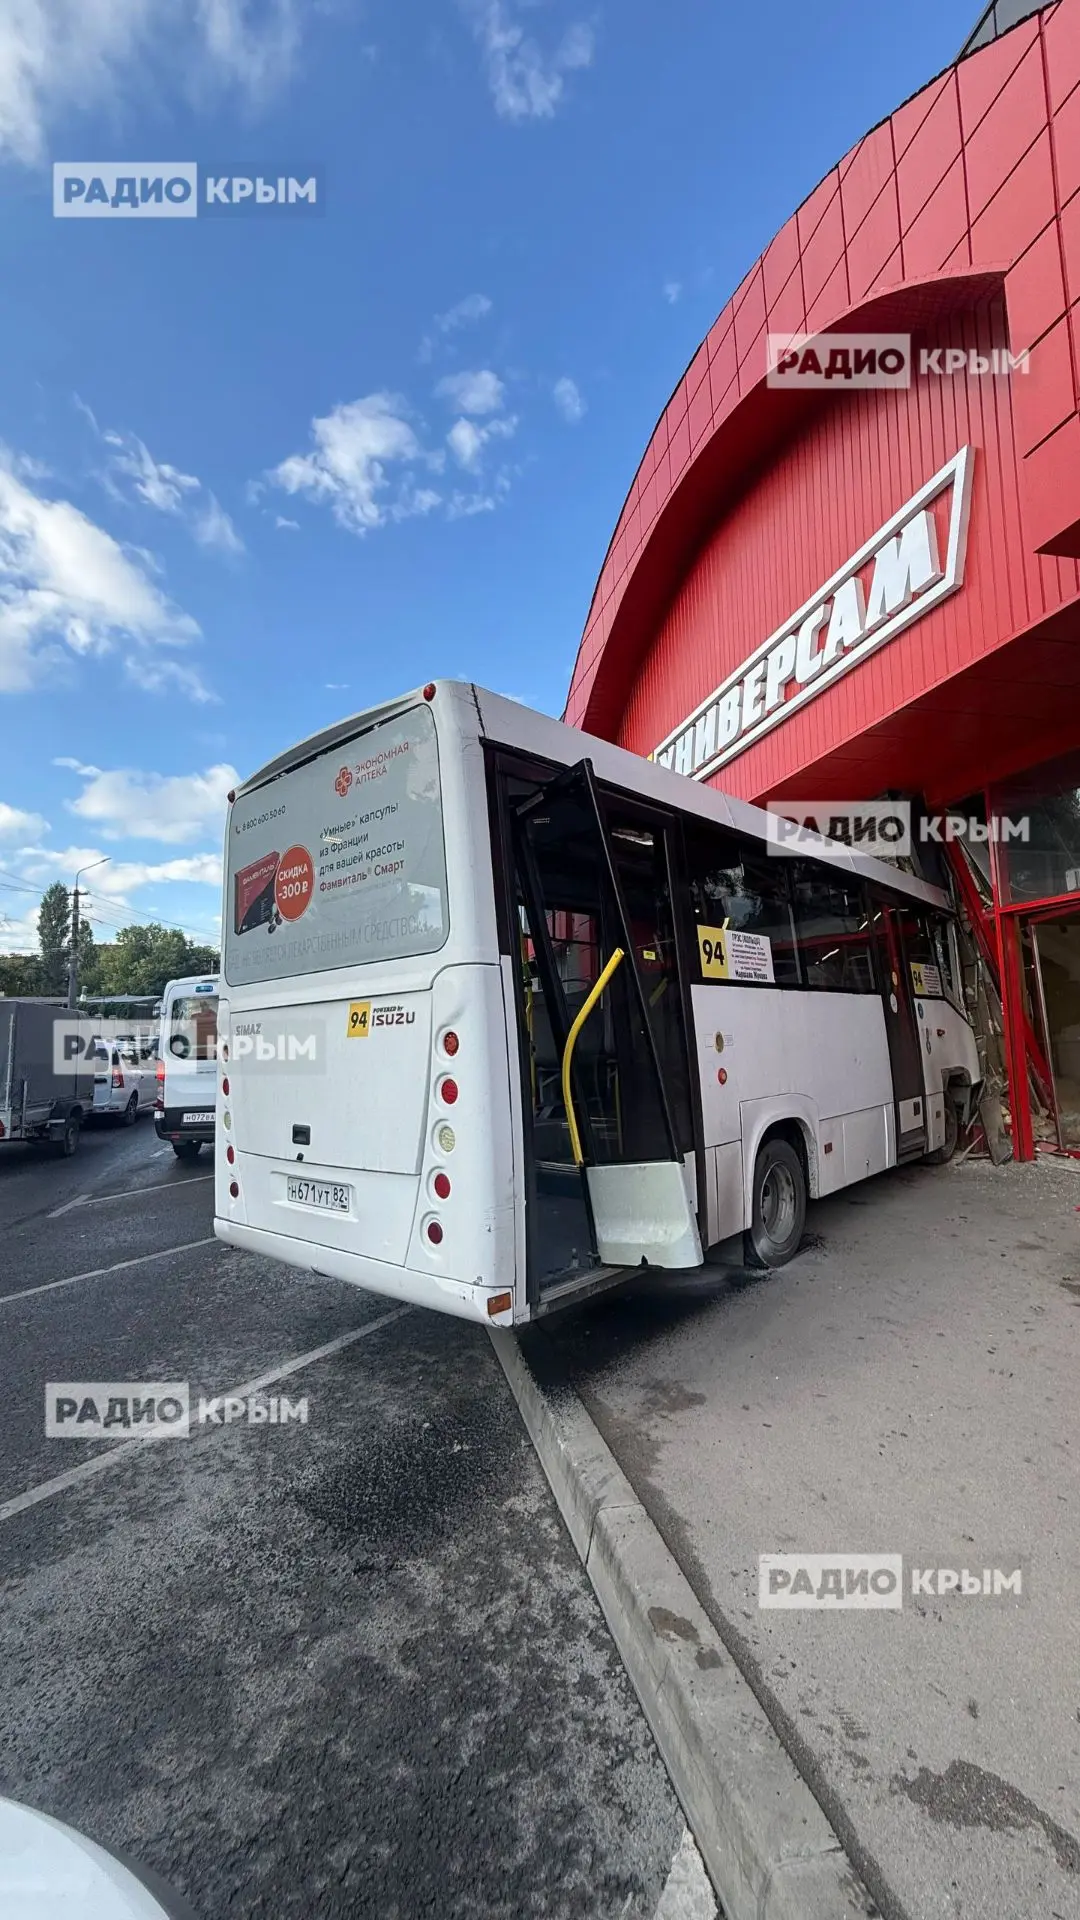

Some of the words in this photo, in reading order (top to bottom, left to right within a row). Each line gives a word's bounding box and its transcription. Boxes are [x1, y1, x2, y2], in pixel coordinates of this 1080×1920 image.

[659, 509, 941, 778] УНИВЕРСАМ
[355, 742, 409, 774] ЭКОНОМНАЯ
[355, 765, 388, 786] АПТЕКА
[359, 802, 399, 824] капсулы
[319, 846, 329, 858] из
[331, 832, 369, 853] Франции
[319, 860, 334, 877] для
[336, 852, 364, 871] вашей
[365, 839, 405, 863] красоты
[374, 858, 405, 877] Смарт
[278, 862, 309, 882] СКИДКА
[702, 939, 725, 966] 94
[912, 970, 922, 987] 94
[351, 1011, 368, 1029] 94
[372, 1011, 415, 1027] ISUZU
[333, 1187, 344, 1203] 82
